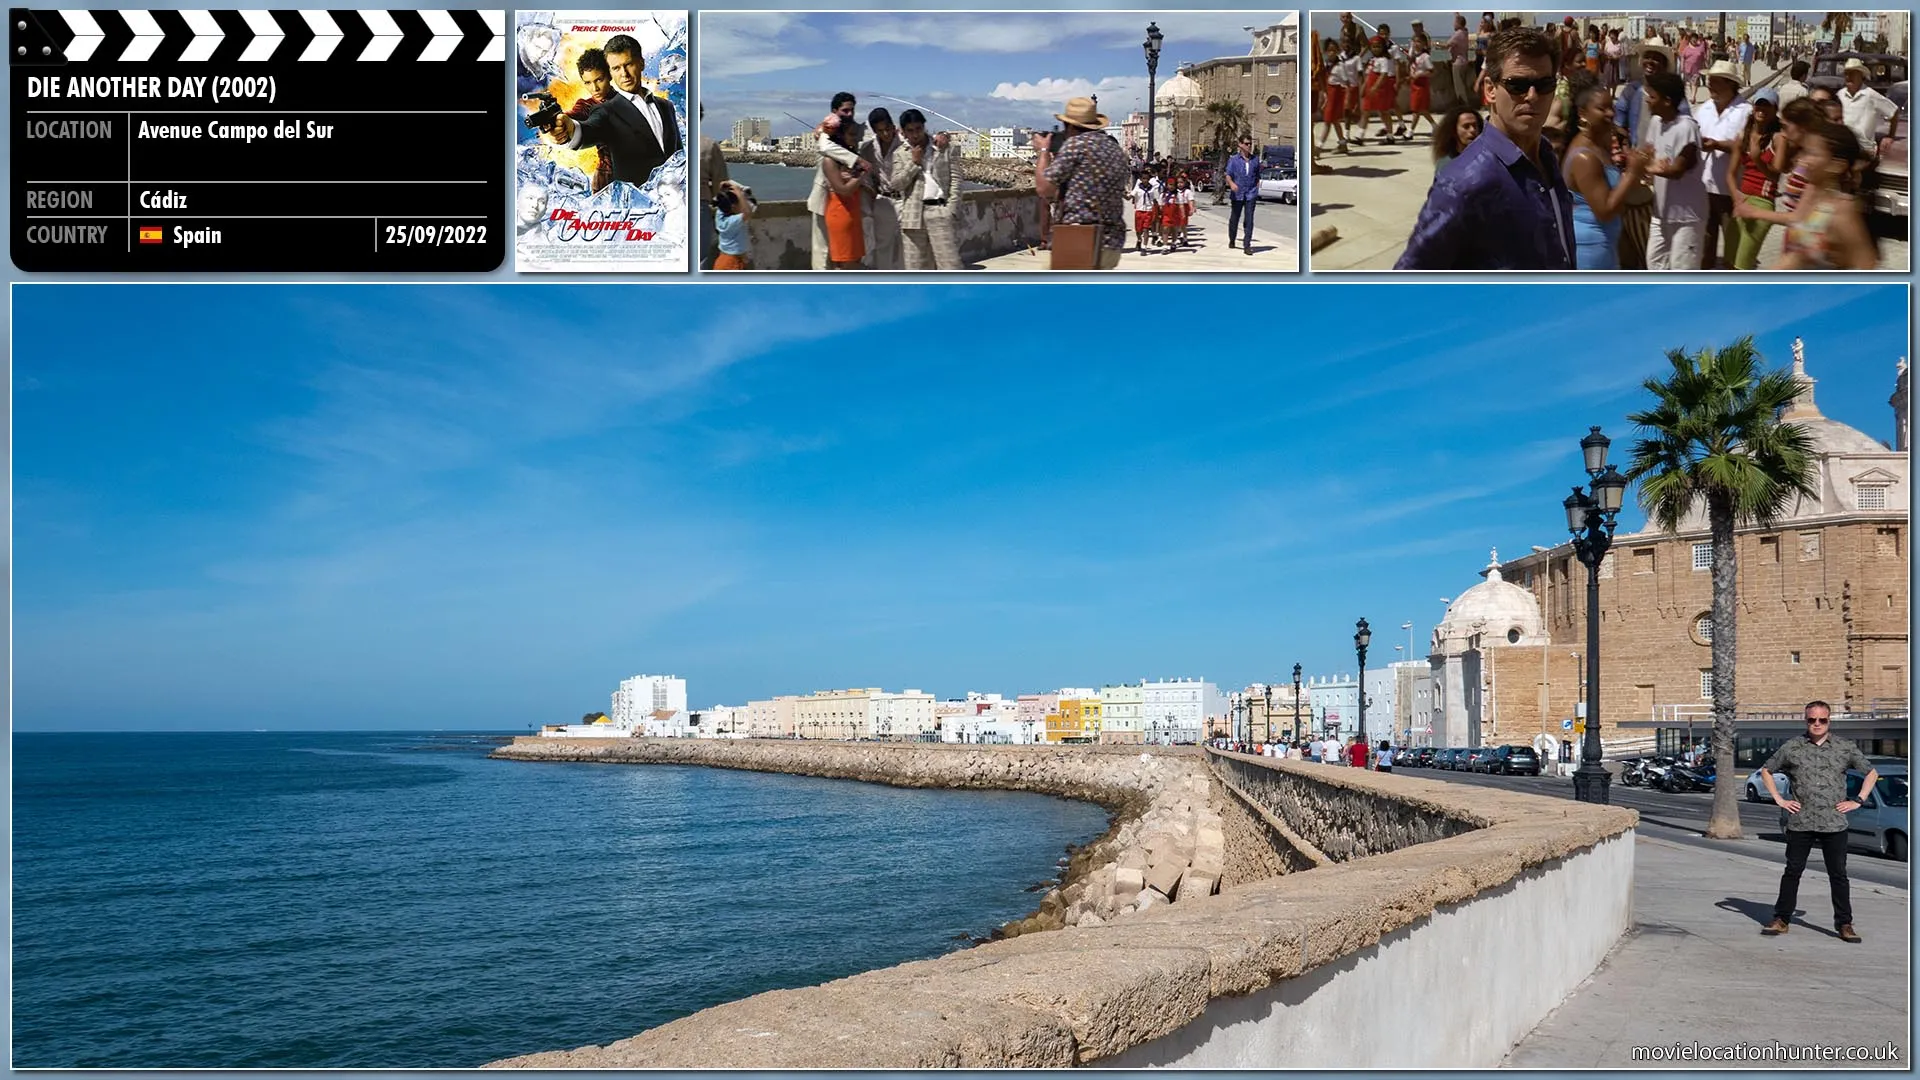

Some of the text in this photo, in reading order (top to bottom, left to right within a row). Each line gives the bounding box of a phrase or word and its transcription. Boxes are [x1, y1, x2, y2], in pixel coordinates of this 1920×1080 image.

[549, 208, 578, 220] DIE
[567, 219, 633, 230] ANOTHER
[625, 229, 656, 241] DAY
